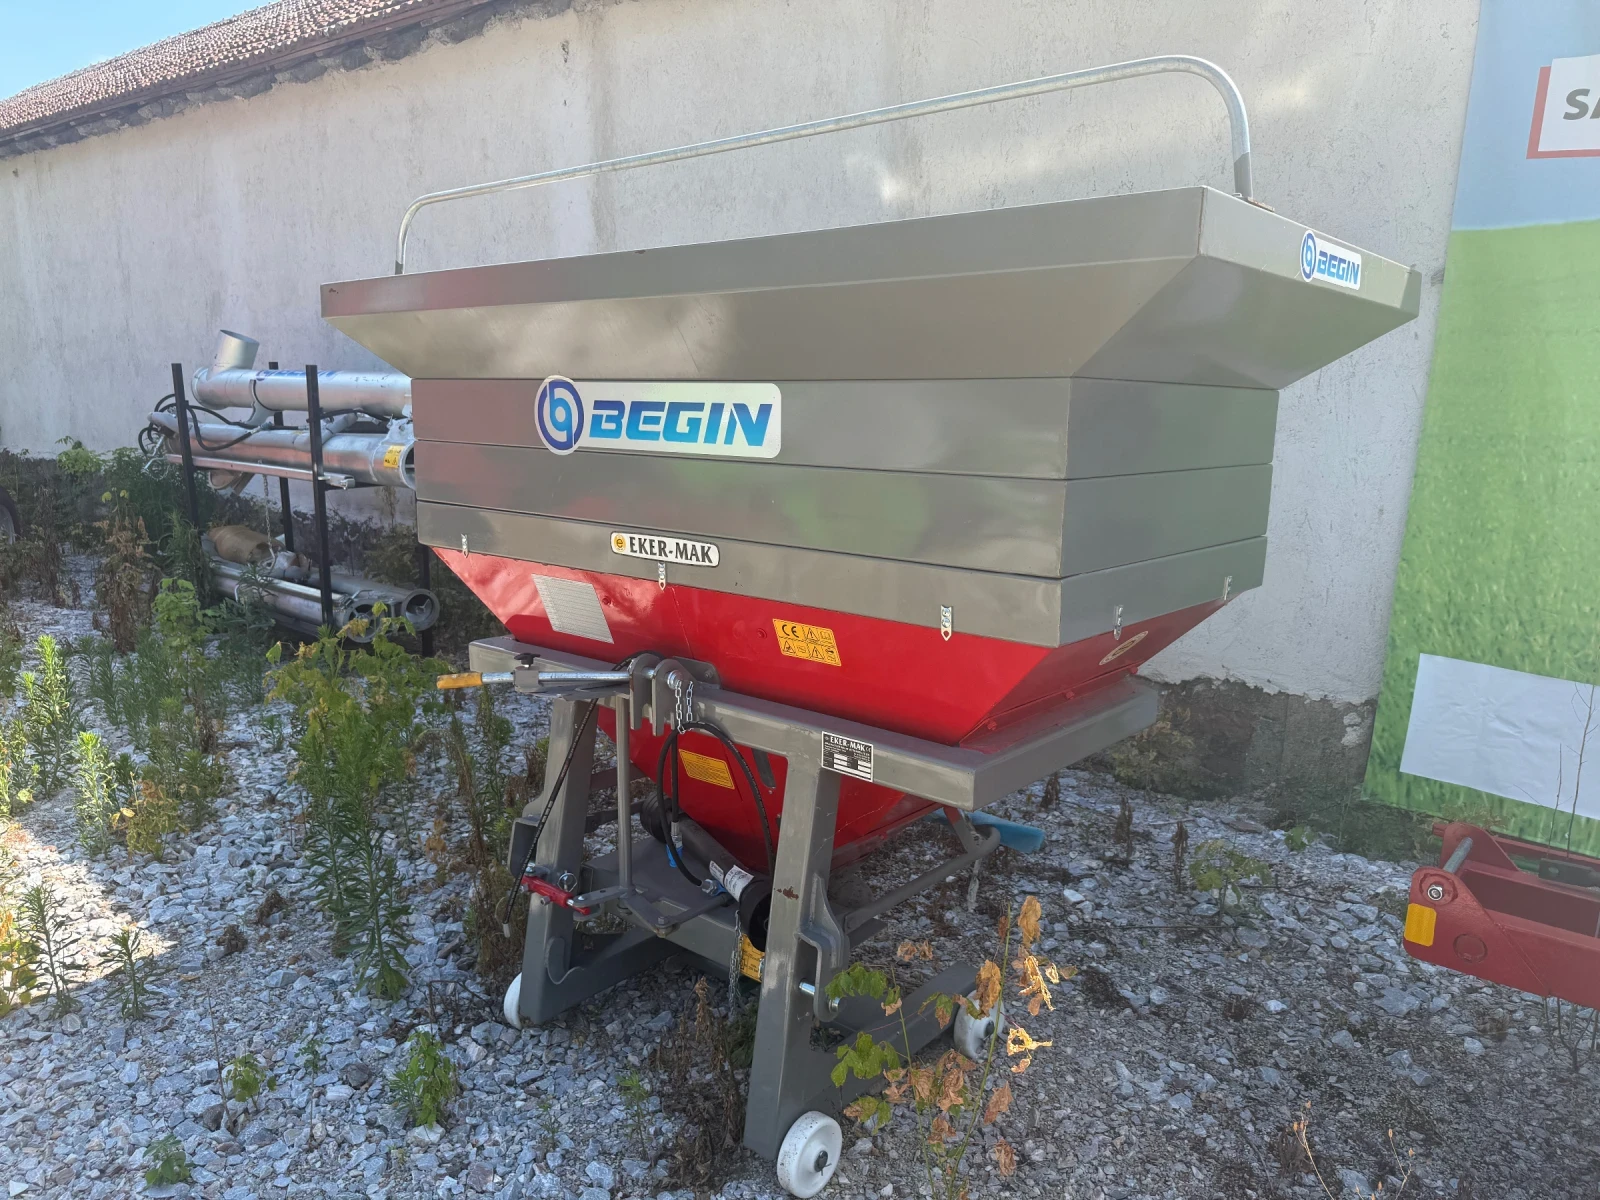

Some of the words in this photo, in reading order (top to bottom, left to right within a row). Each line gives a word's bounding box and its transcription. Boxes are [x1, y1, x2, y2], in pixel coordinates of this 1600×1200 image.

[1316, 250, 1360, 285] BEGIN
[589, 400, 773, 447] BEGIN
[629, 536, 713, 564] EKER-MAK
[830, 736, 866, 752] EKER-MAK
